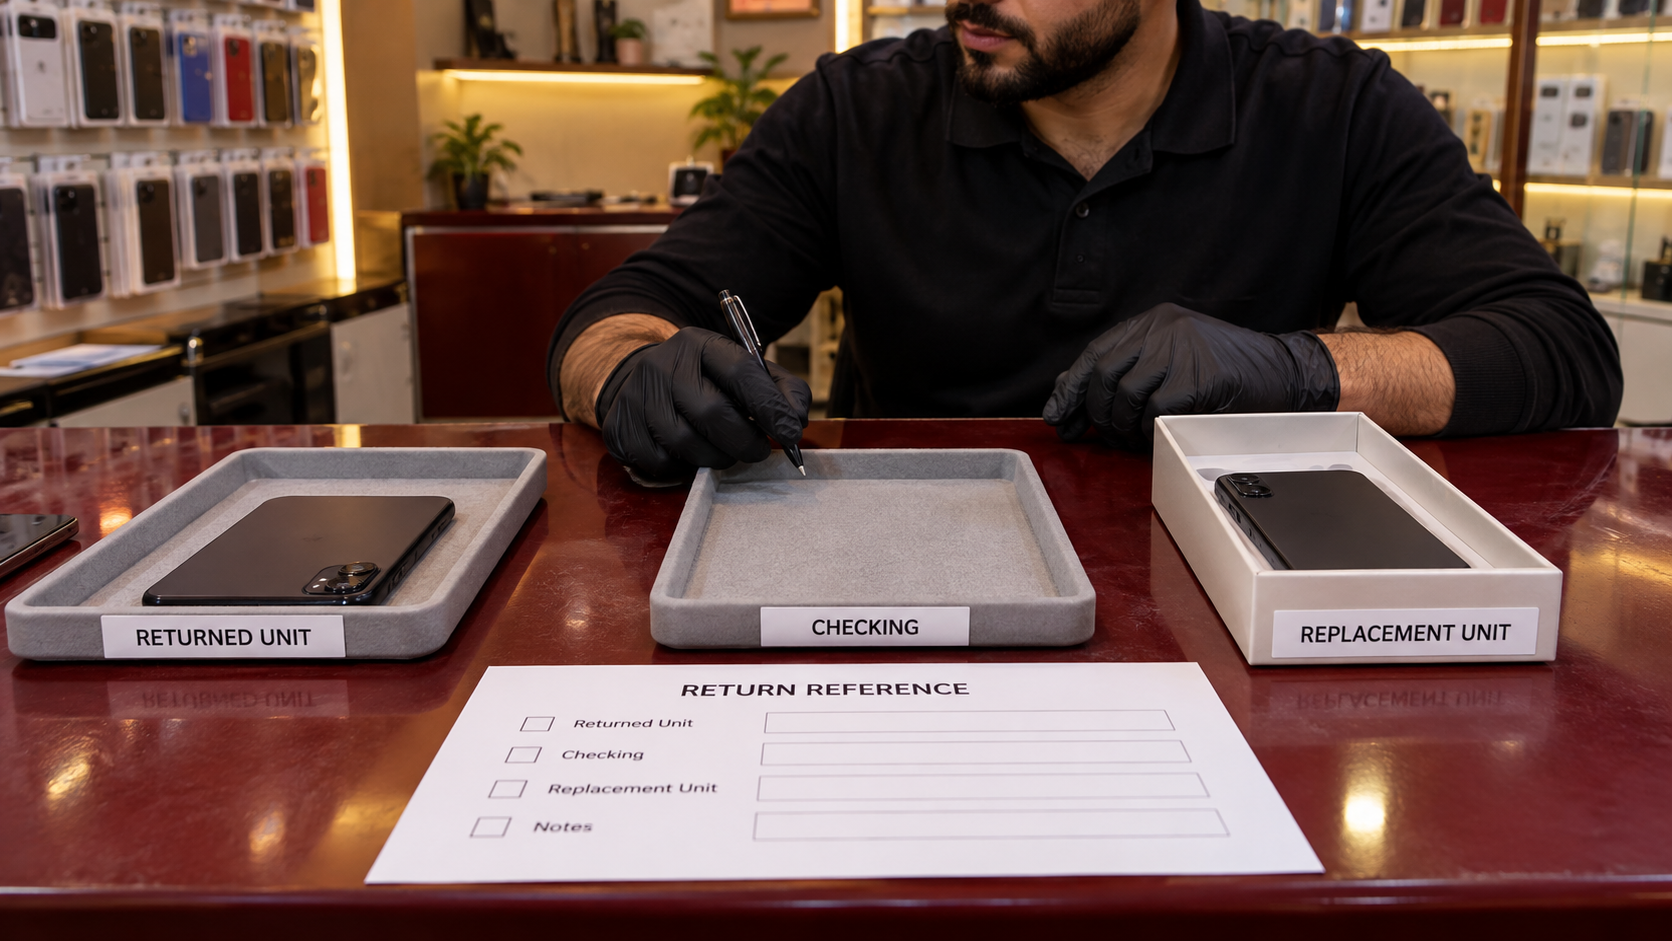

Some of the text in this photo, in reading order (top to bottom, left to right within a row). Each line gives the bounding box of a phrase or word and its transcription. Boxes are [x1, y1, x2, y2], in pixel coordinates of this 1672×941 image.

[811, 618, 919, 636] CHECKING
[1301, 623, 1512, 643] REPLACEMENT UNIT
[137, 628, 312, 646] RETURNED UNIT
[680, 681, 970, 698] RETURN REFERENCE
[573, 718, 693, 729] Returned Unit
[561, 749, 644, 762] Checking
[547, 782, 719, 798] Replacement Unit
[533, 820, 593, 833] Notes
